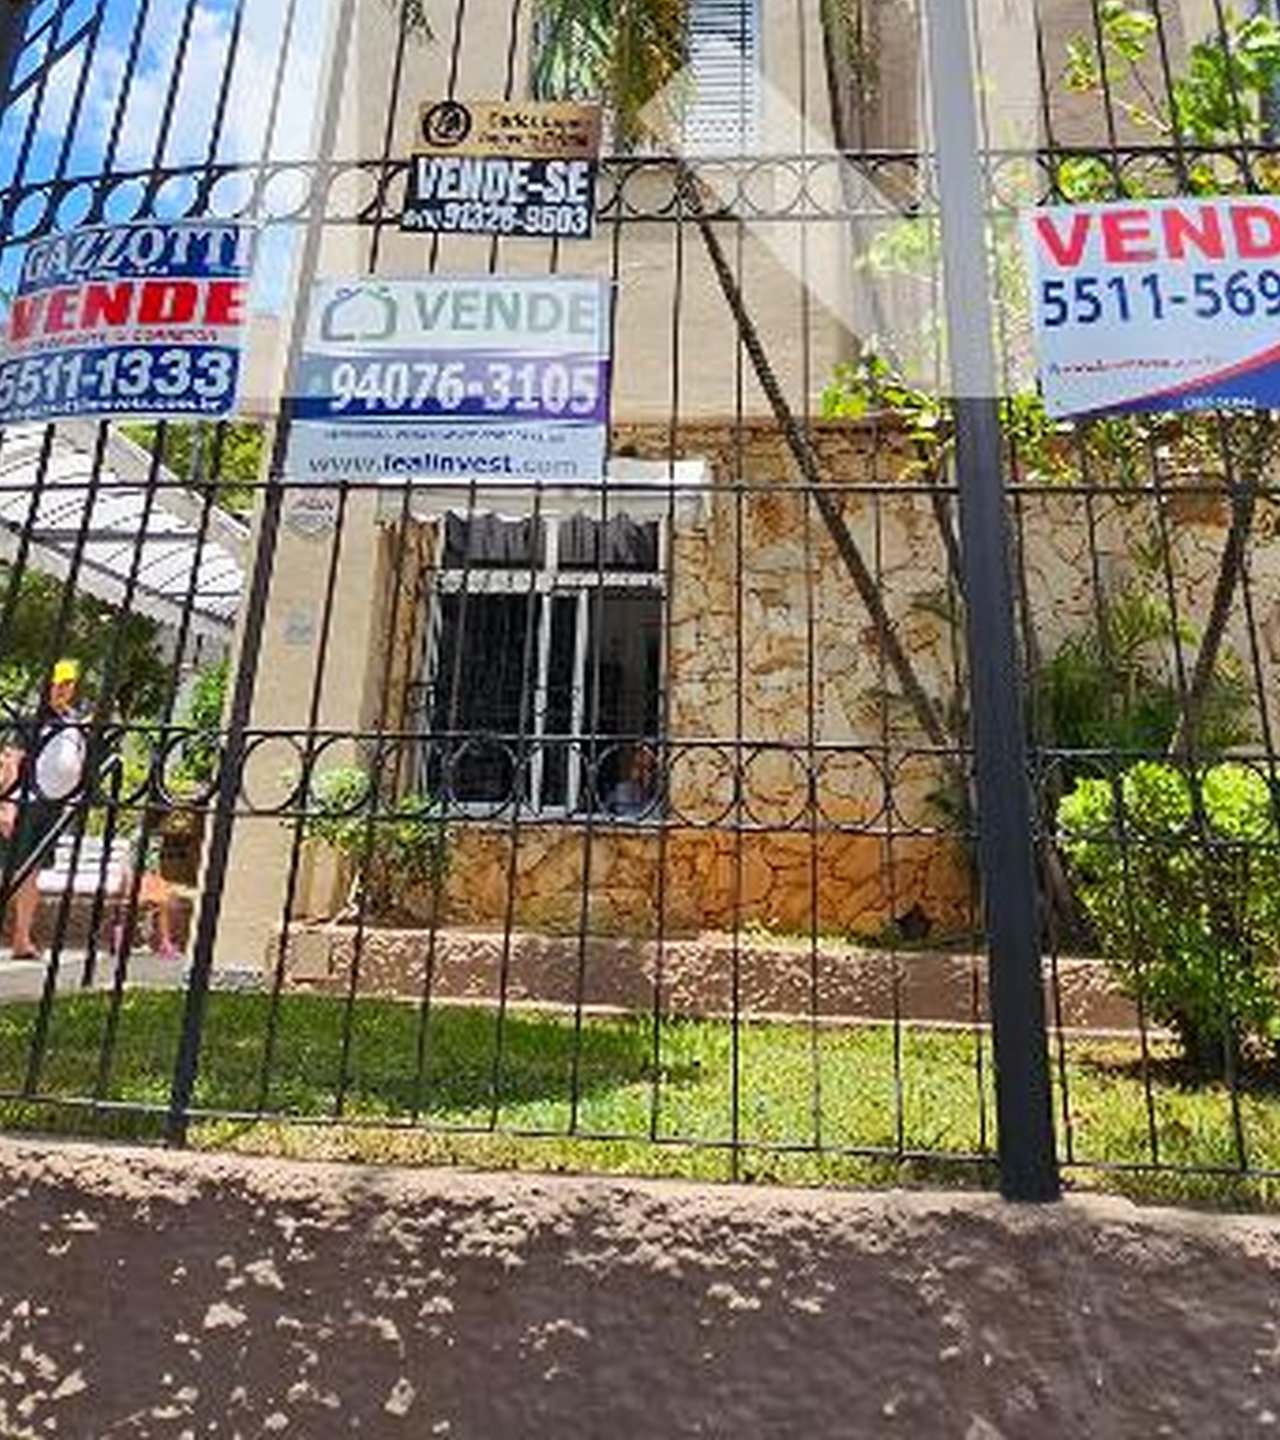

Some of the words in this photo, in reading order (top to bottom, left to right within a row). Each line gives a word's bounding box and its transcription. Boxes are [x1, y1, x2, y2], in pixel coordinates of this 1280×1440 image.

[417, 158, 589, 204] VENDE-SE
[9, 281, 246, 343] VENDE
[415, 289, 598, 334] VENDE
[330, 363, 601, 413] 94076-3105
